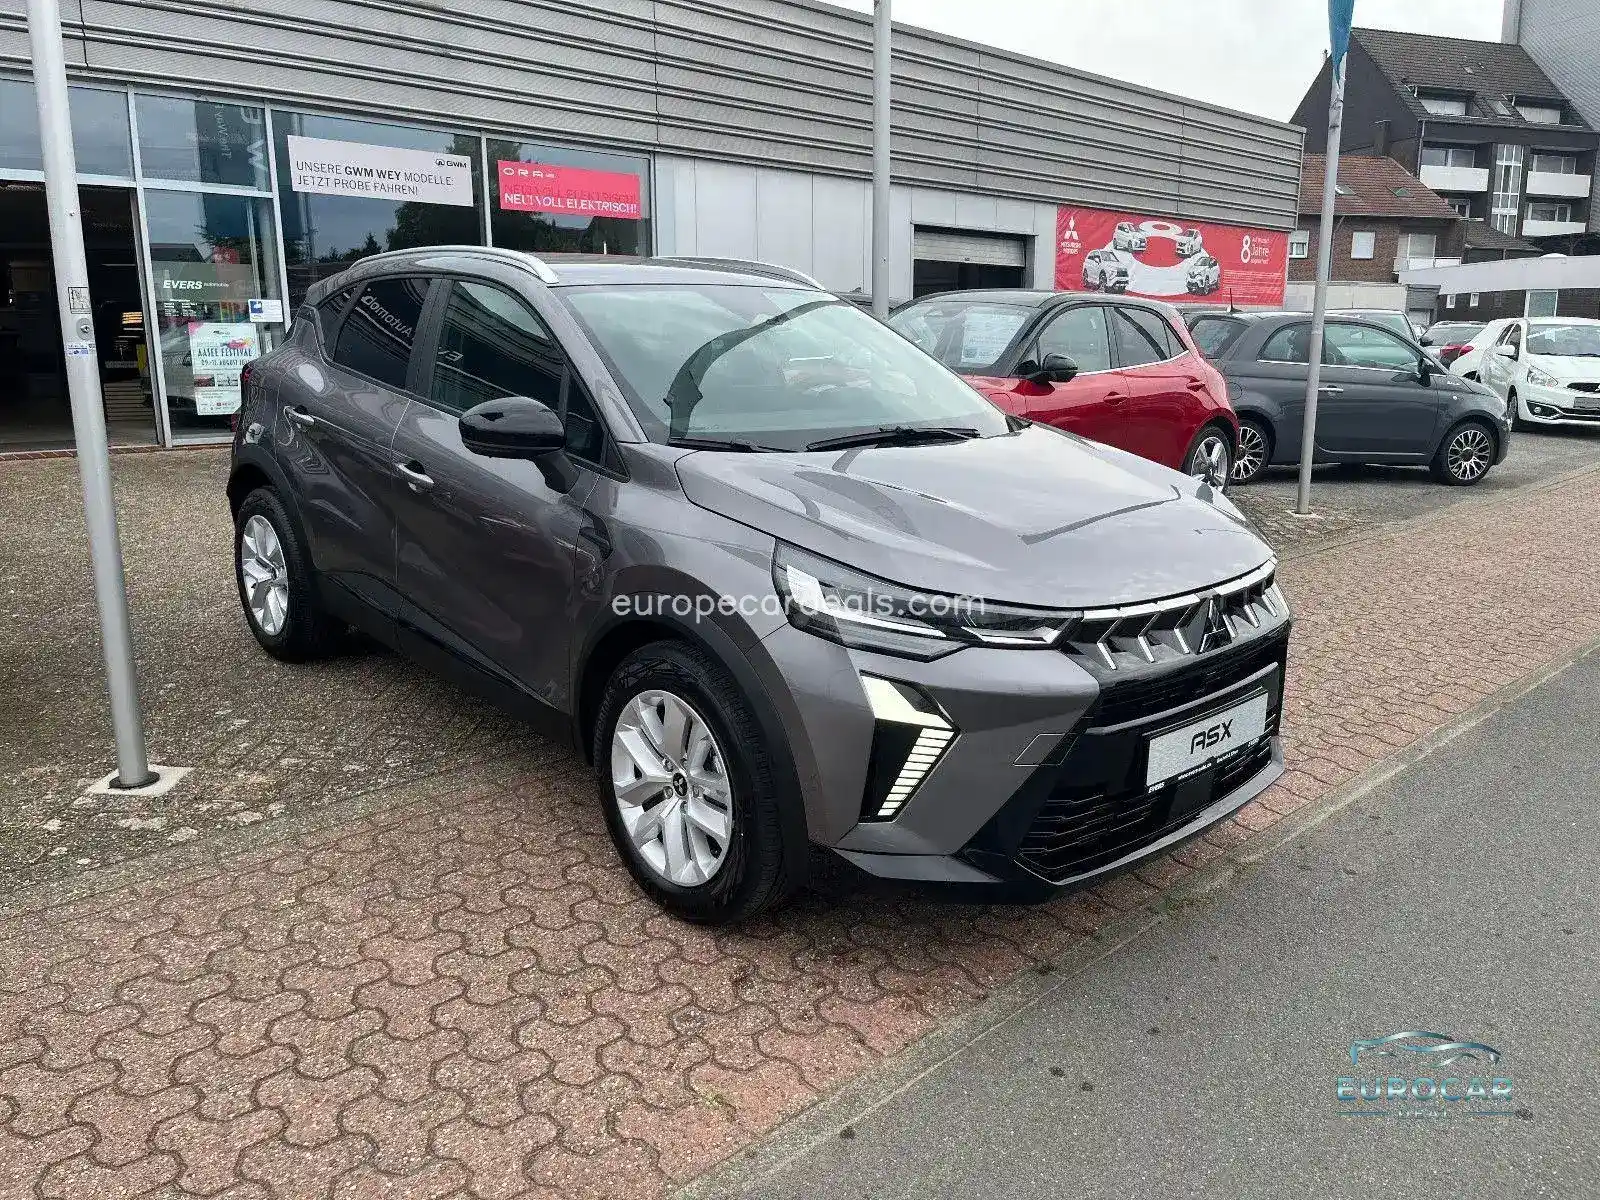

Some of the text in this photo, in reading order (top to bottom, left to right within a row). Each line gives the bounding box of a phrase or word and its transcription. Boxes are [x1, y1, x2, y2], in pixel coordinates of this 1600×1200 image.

[296, 160, 342, 175] UNSERE
[344, 165, 374, 178] GWM
[376, 168, 401, 181] WEY
[297, 174, 418, 196] JETZT PROBE FAHREN!
[566, 198, 637, 214] ELEKTRISCH!
[1241, 234, 1270, 264] 8 Jahre
[163, 279, 203, 290] EVERS
[221, 348, 252, 357] FESTIVAL
[1190, 718, 1234, 755] ASX
